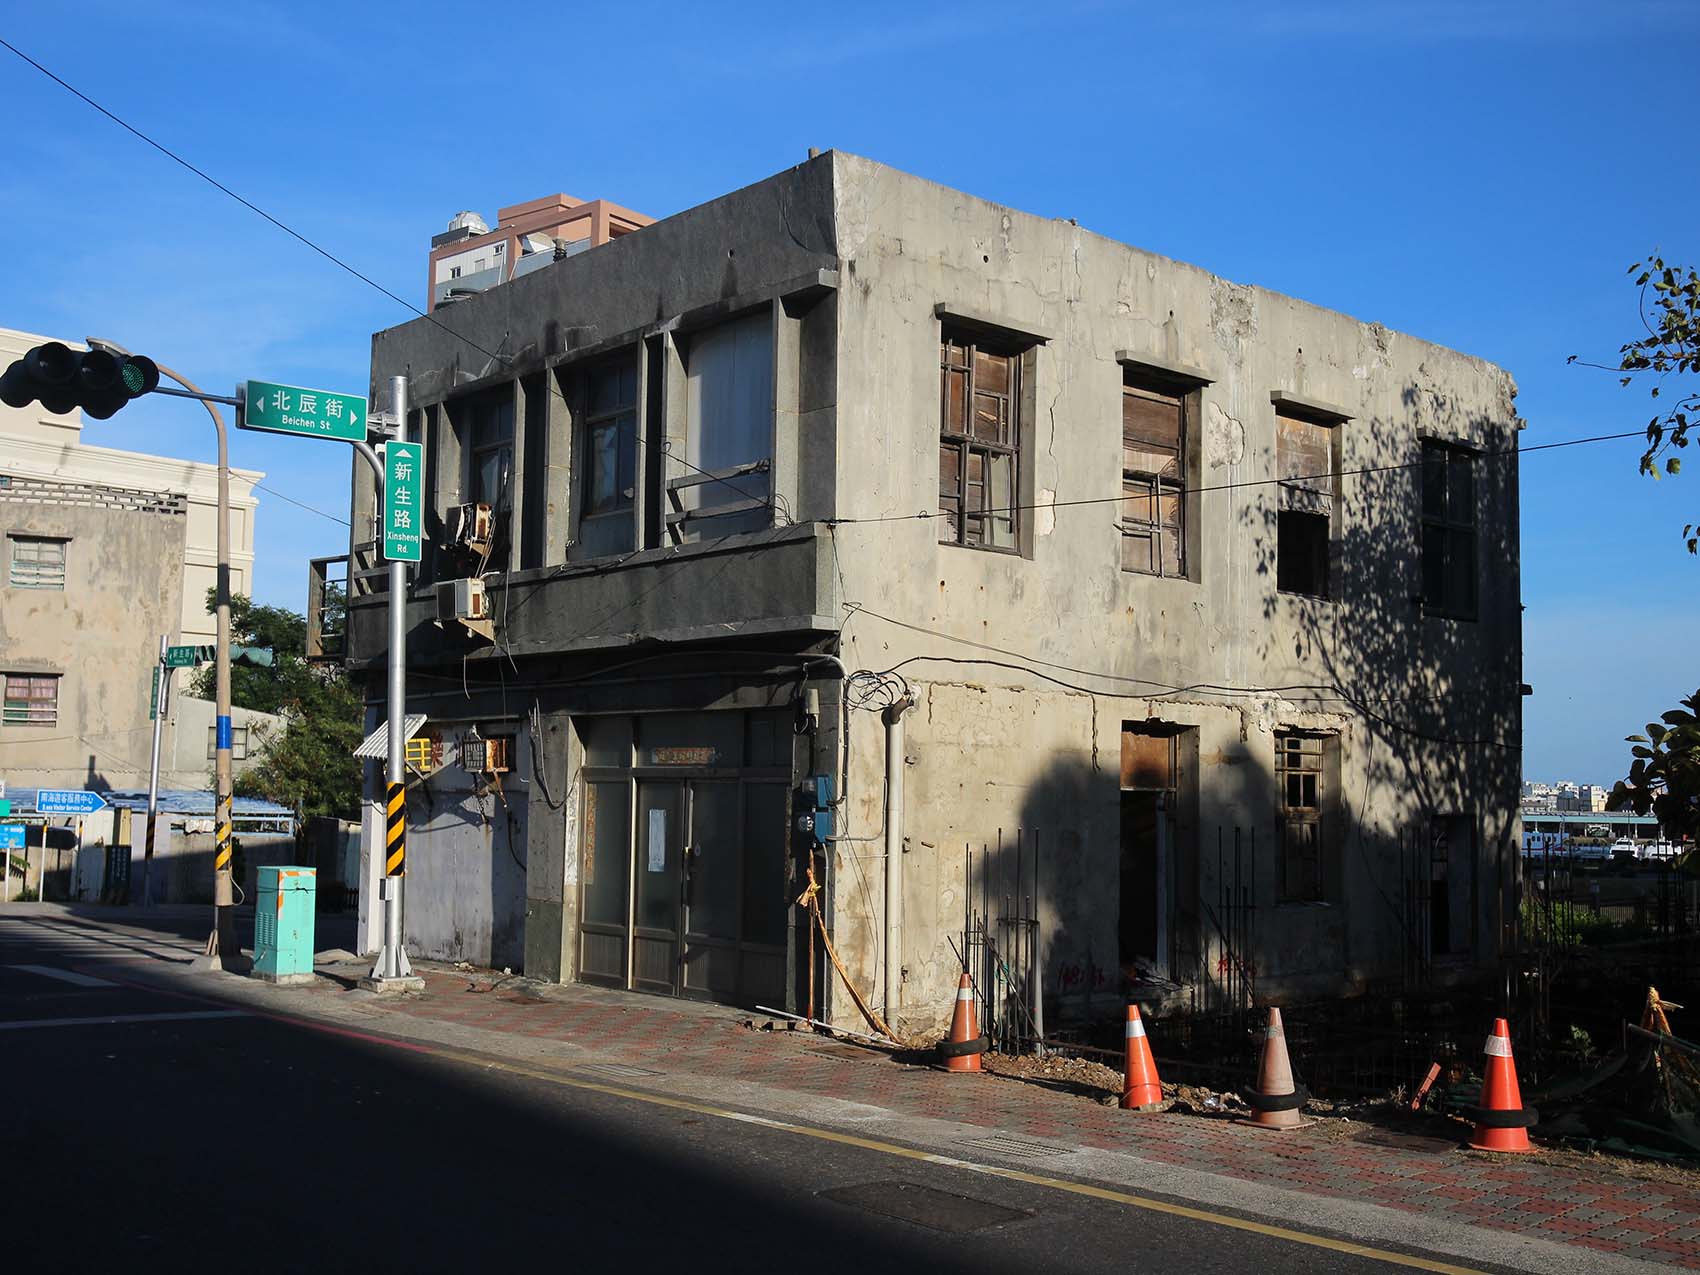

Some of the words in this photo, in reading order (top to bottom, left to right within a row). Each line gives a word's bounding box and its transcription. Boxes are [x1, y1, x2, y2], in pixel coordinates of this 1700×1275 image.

[272, 390, 343, 418] 北辰街
[282, 415, 315, 428] Beichen
[320, 420, 332, 431] St.
[394, 461, 413, 529] 新生路
[387, 531, 419, 544] Xinsheng
[397, 544, 409, 553] Rd.
